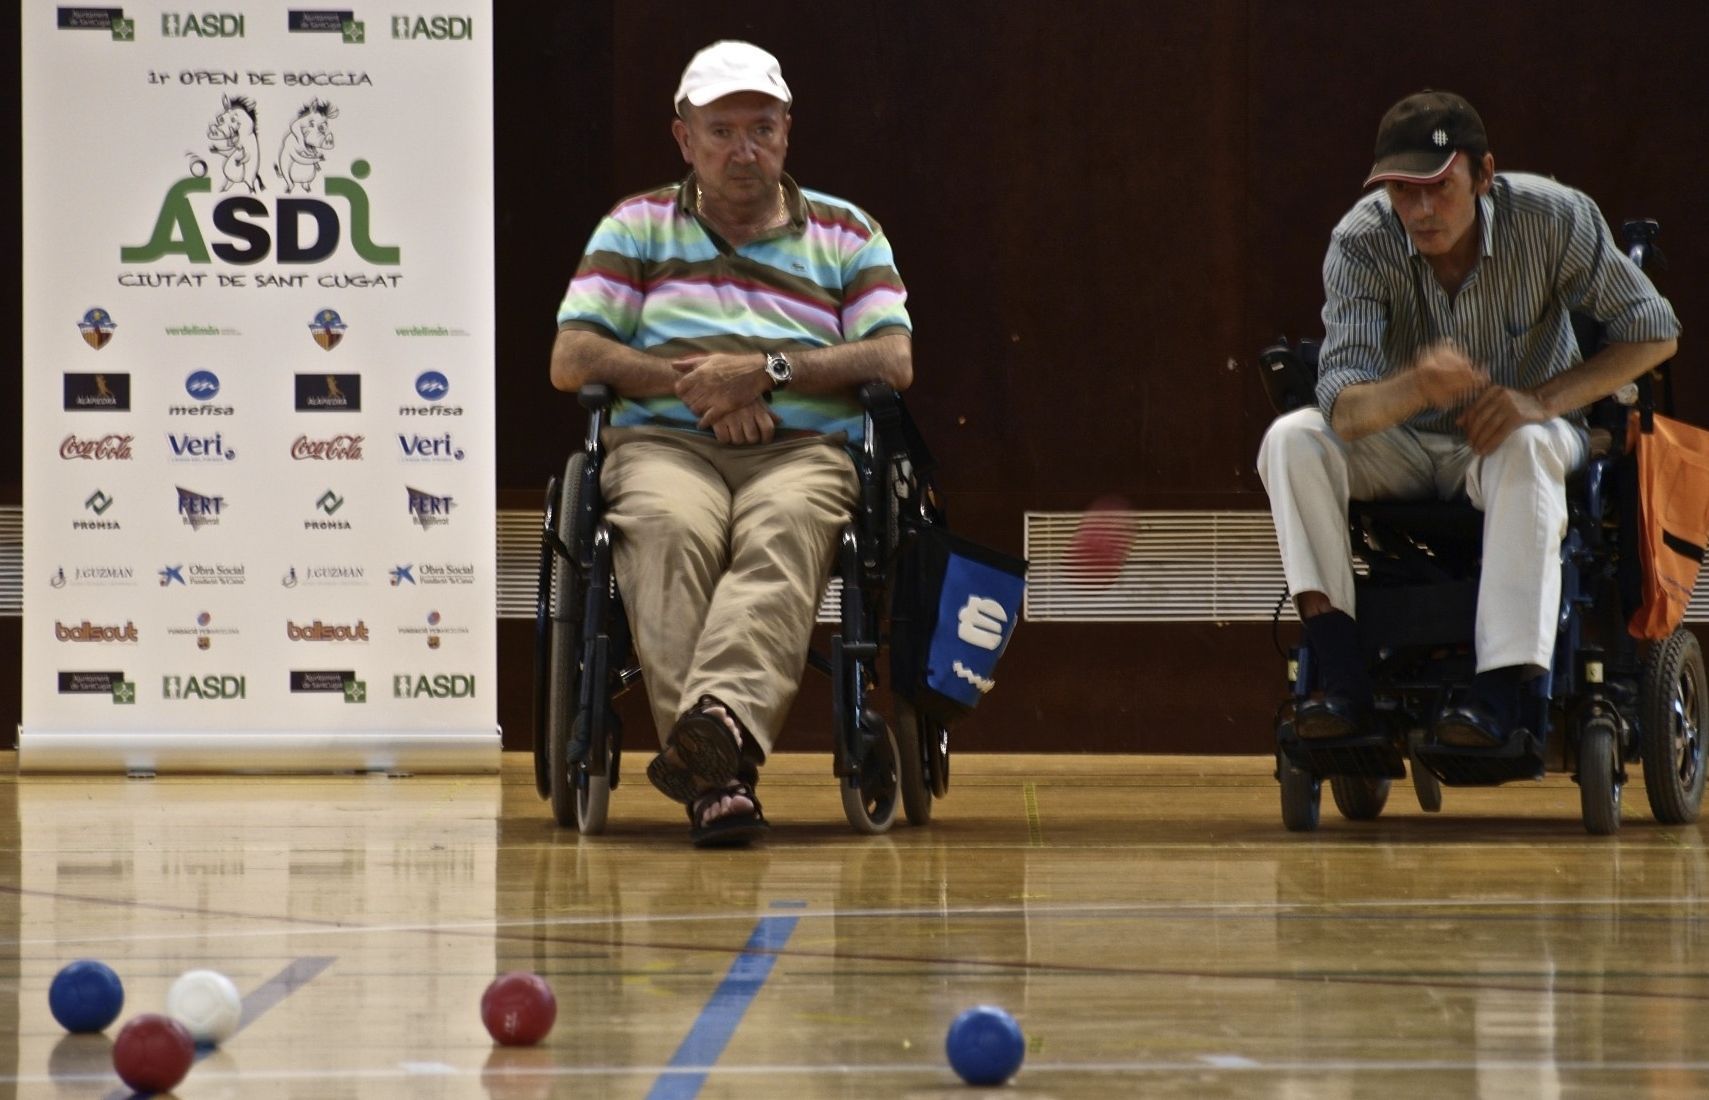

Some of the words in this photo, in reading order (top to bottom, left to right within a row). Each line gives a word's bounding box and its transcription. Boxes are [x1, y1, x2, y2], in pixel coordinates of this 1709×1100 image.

[182, 14, 245, 37] ASDI
[412, 16, 472, 40] ASDI
[180, 71, 239, 85] OPEN
[248, 72, 276, 85] DE
[283, 72, 373, 86] BOCCIA
[118, 273, 208, 287] CIUTAT
[217, 274, 246, 287] DE
[255, 274, 308, 288] SANT
[317, 274, 403, 288] CUGAT
[168, 405, 235, 416] mefisa
[399, 405, 464, 416] mefisa
[168, 432, 223, 456] Veri
[399, 432, 451, 456] Veri
[177, 496, 224, 514] FERT
[408, 496, 454, 514] FERT
[189, 565, 215, 576] Obra
[217, 564, 245, 575] Social
[419, 564, 445, 575] Obra
[447, 563, 474, 575] Social
[184, 676, 246, 699] ASDI
[413, 674, 476, 699] ASDI
